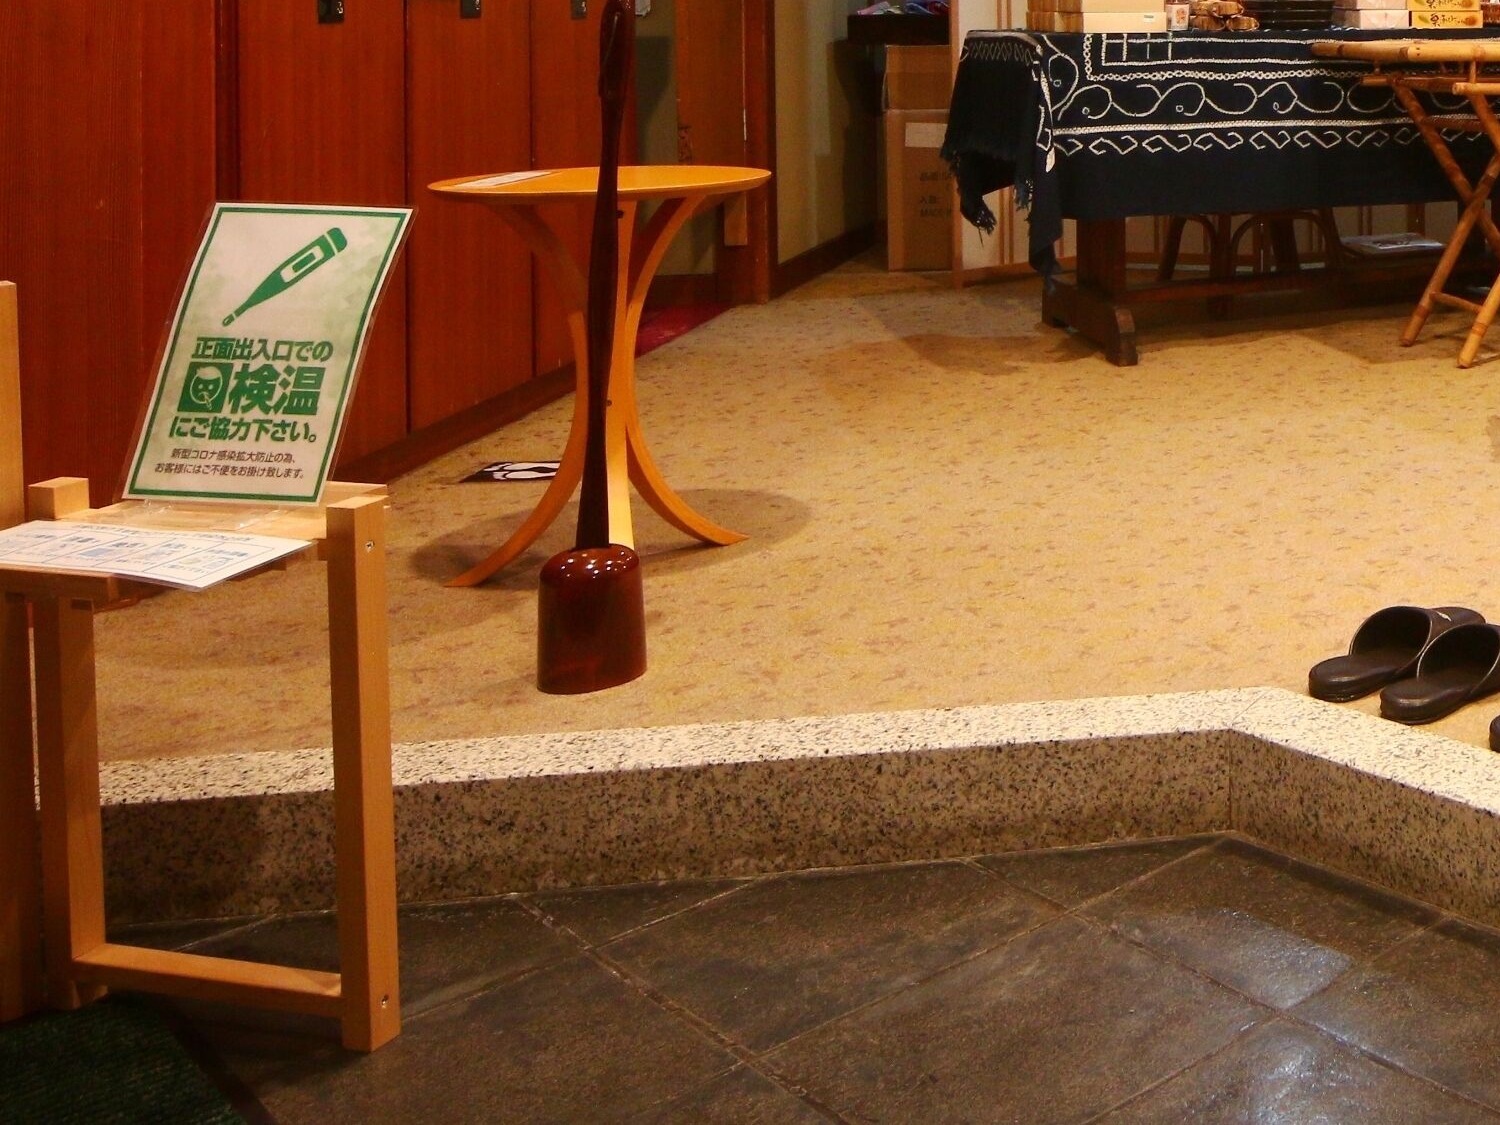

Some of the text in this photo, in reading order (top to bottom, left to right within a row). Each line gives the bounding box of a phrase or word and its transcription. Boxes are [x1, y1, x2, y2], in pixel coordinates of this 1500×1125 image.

[191, 336, 334, 363] 正面出入口での
[228, 363, 327, 416] 検温
[168, 415, 317, 444] にご協力下さい。
[170, 447, 297, 464] 新型コロナ感染拡大防止の為、
[154, 462, 305, 479] お客様にはご不便をお掛け致します。
